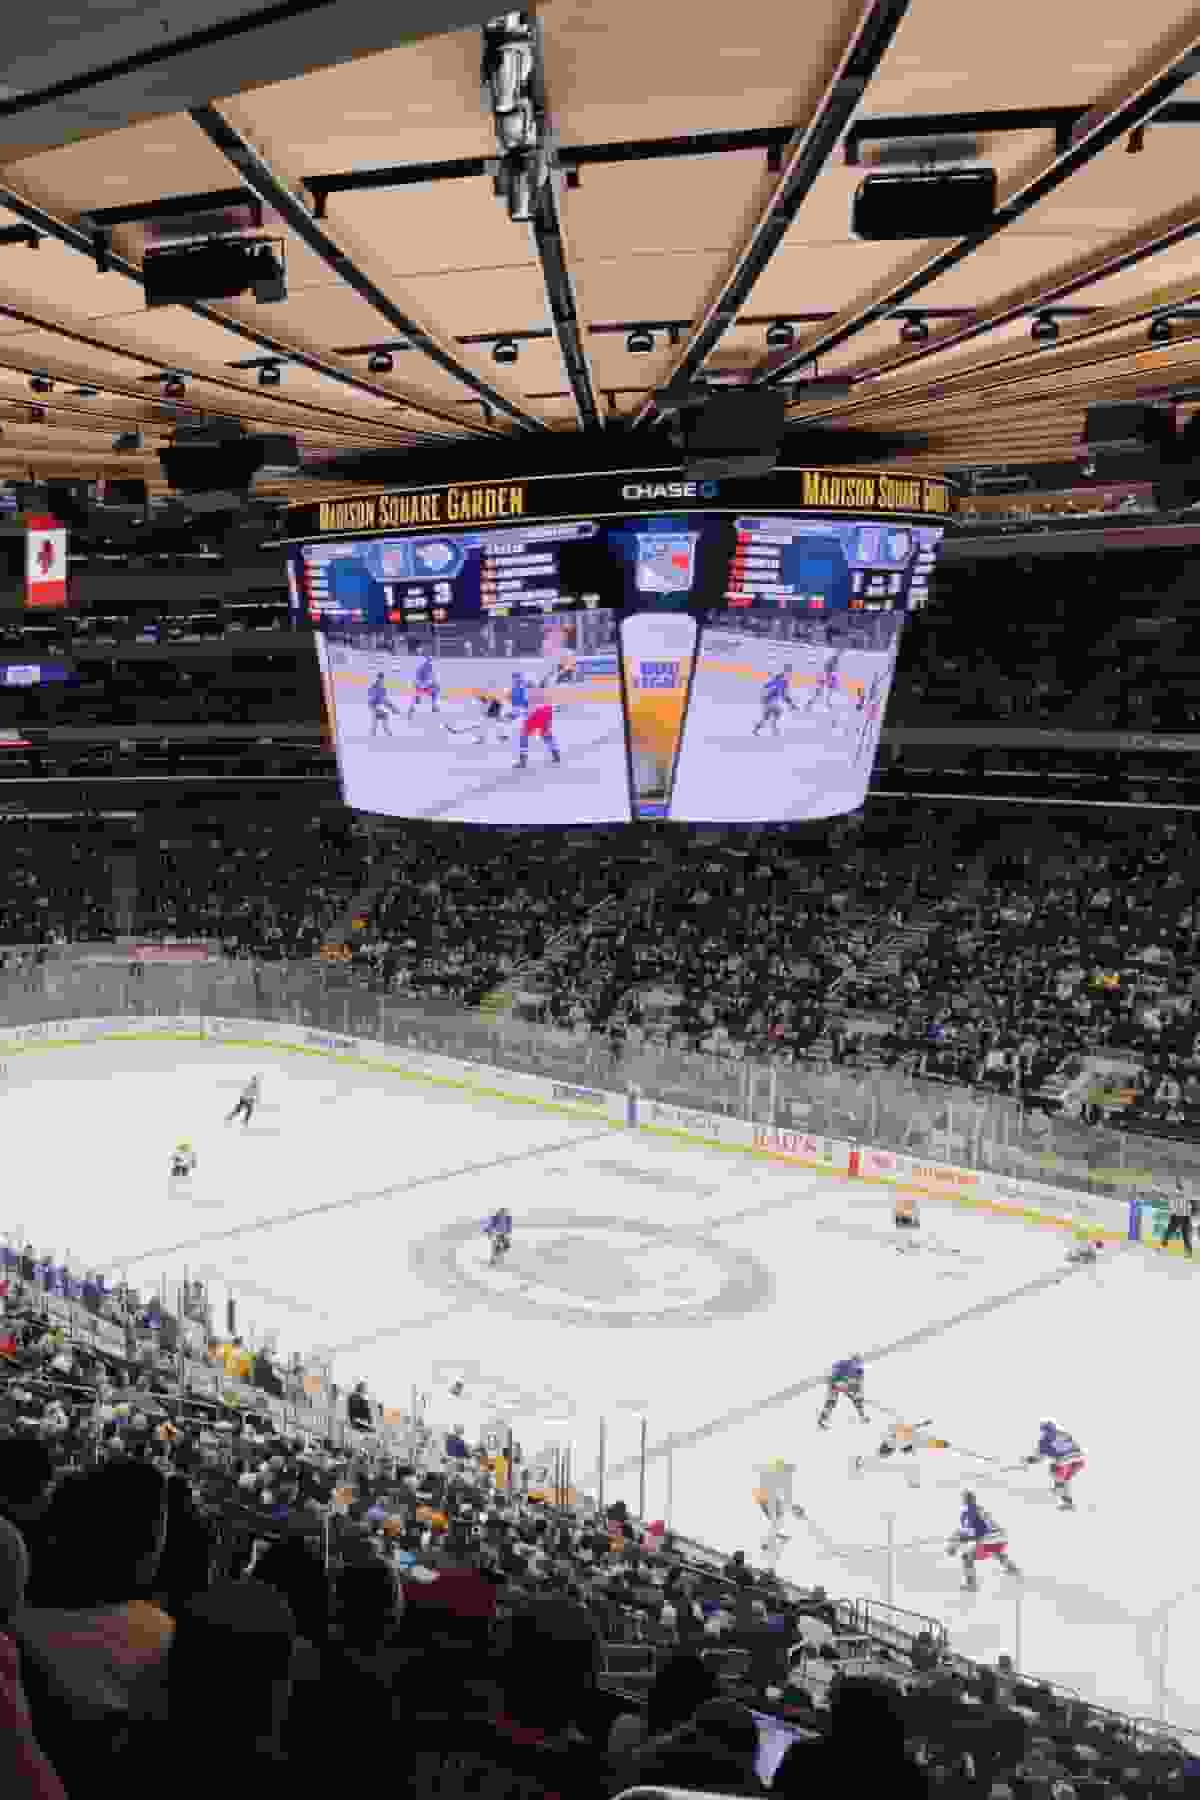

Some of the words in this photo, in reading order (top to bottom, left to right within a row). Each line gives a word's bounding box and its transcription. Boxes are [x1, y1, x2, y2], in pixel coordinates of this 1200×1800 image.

[622, 482, 697, 499] CHASE
[802, 472, 875, 506] MADISON
[378, 494, 441, 527] SQUARE
[446, 487, 524, 521] GARDEN
